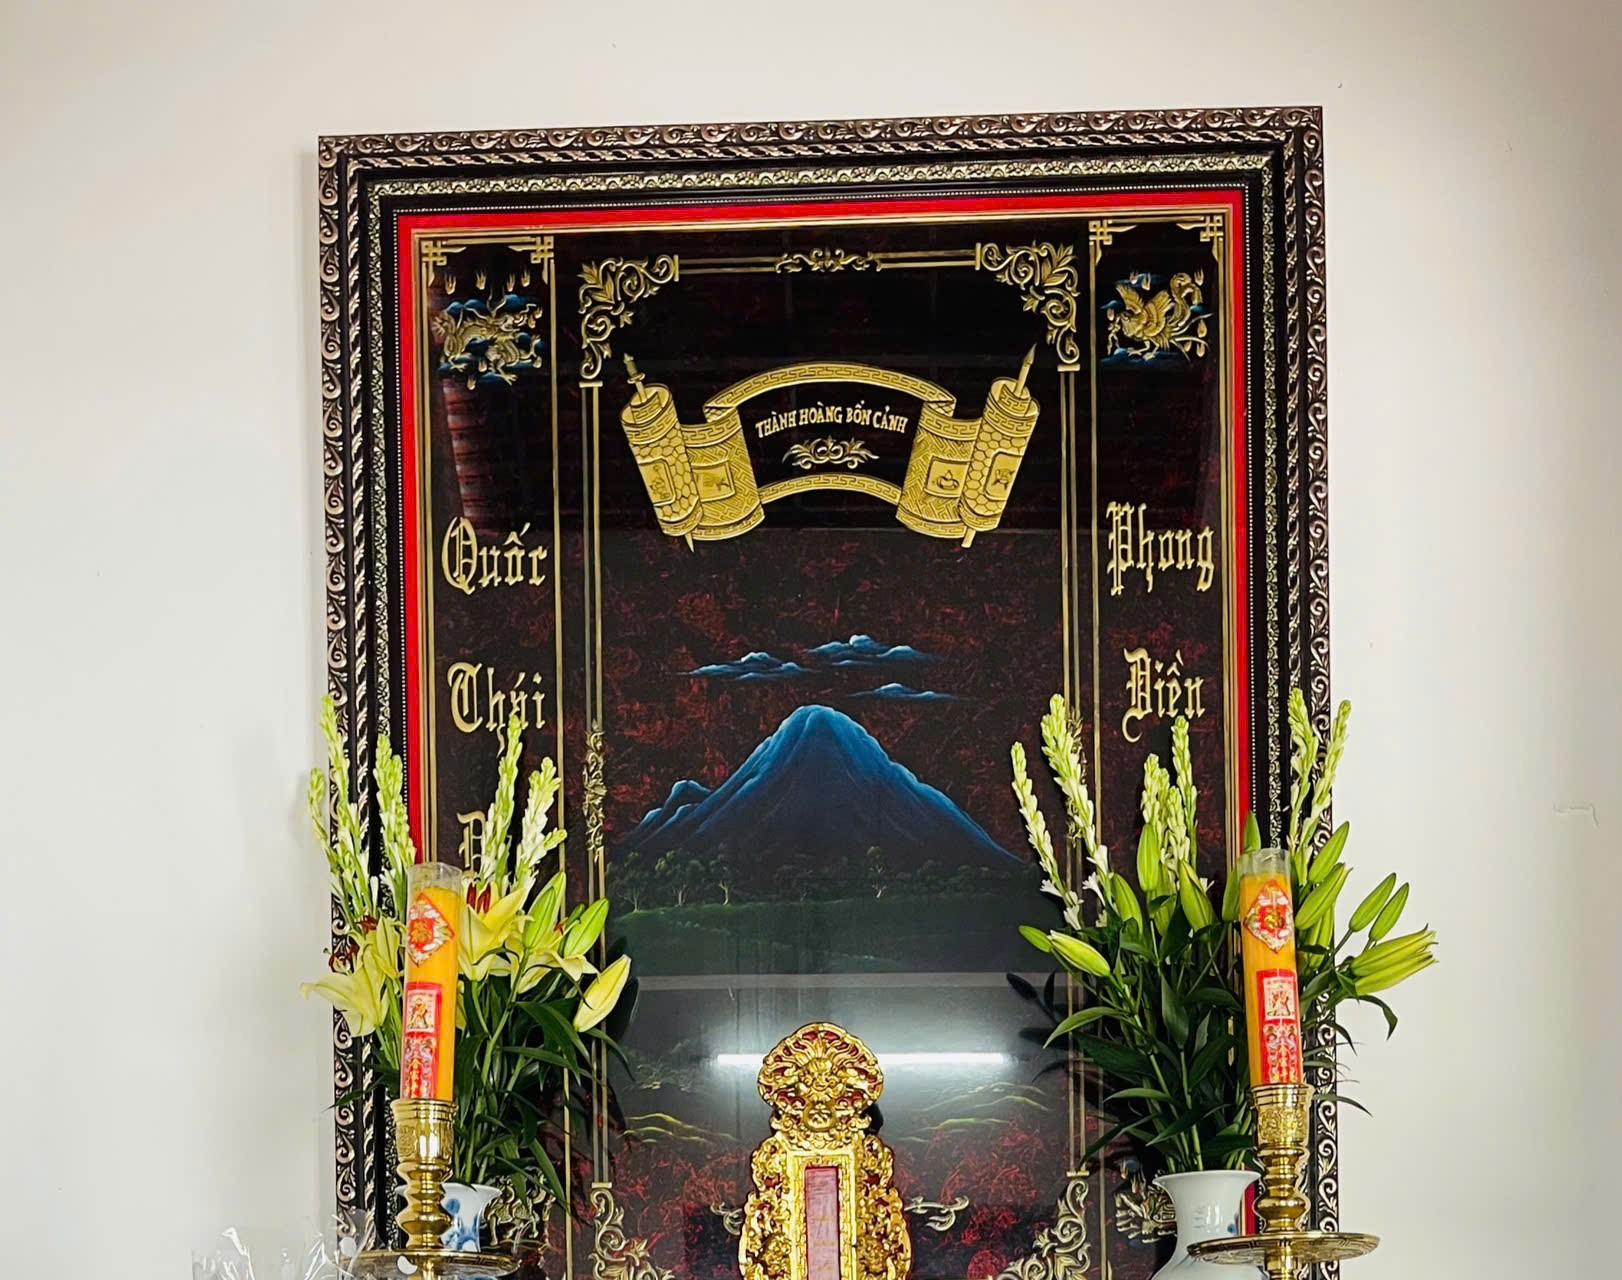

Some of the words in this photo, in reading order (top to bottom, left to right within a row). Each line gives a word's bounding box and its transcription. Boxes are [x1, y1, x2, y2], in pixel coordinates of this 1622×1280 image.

[755, 411, 797, 438] THÀNH
[799, 401, 843, 425] HOÀNG
[873, 405, 908, 434] CẢNH
[1106, 501, 1214, 596] Phong
